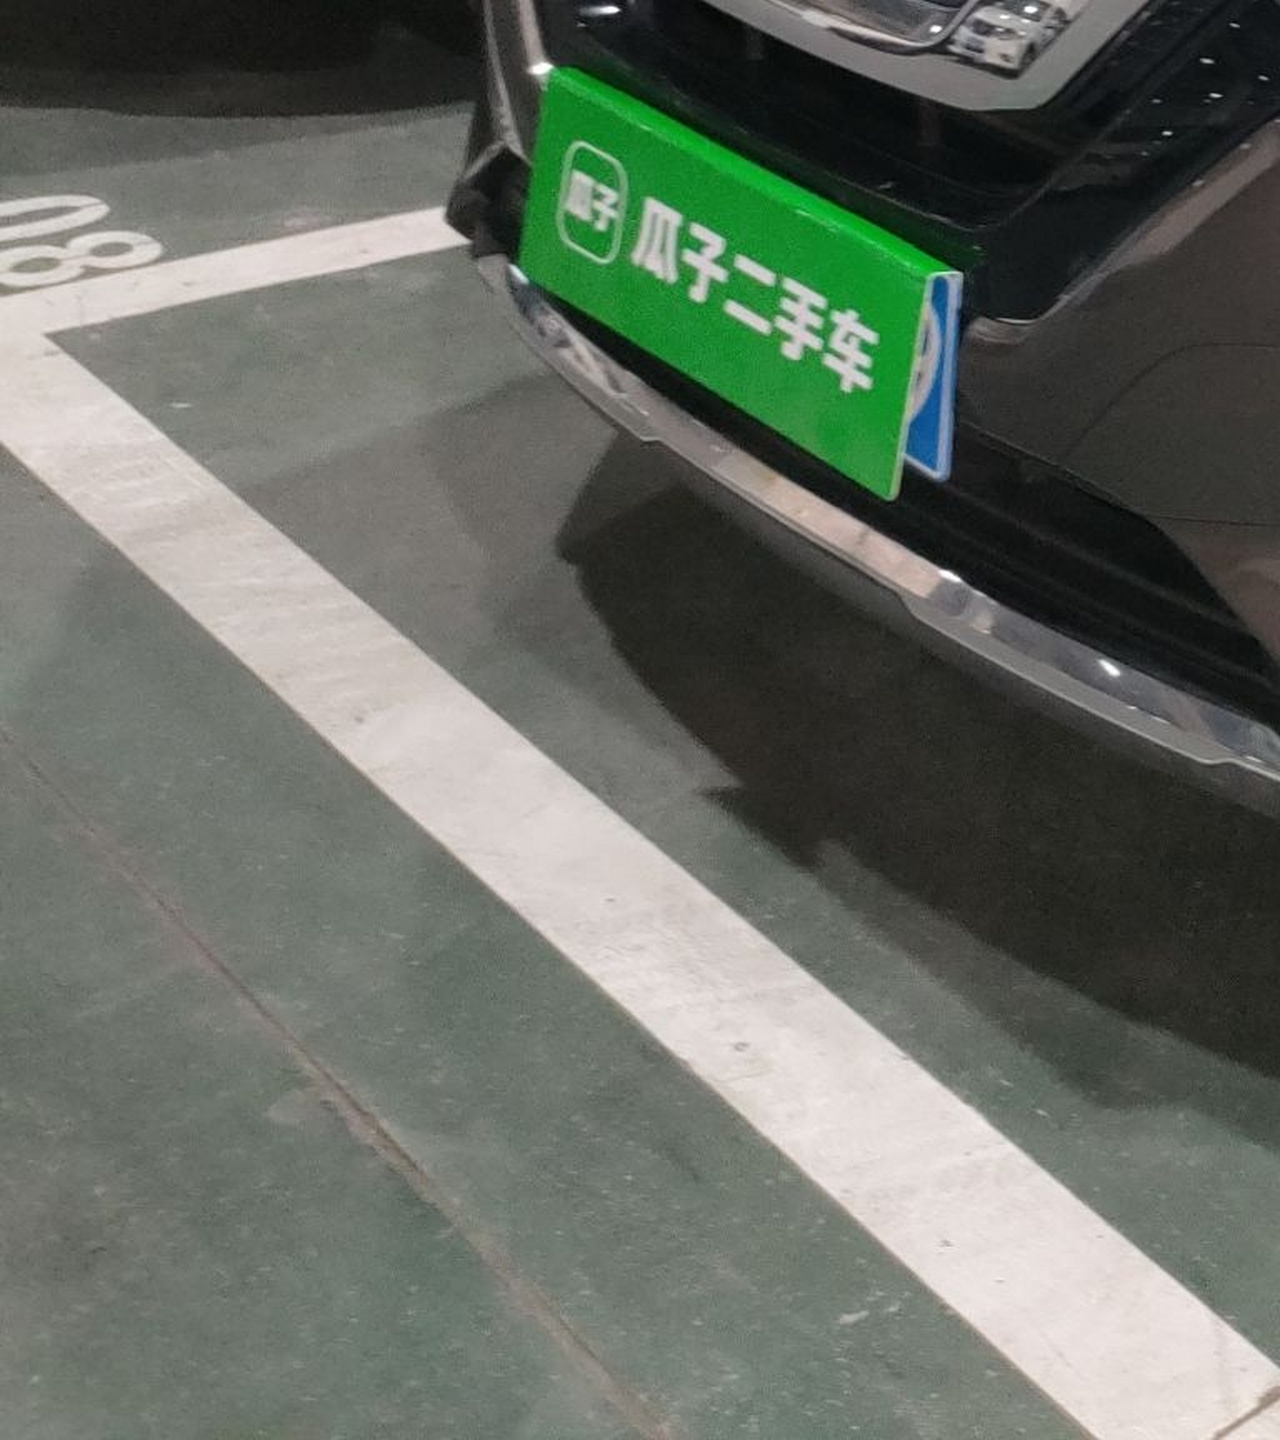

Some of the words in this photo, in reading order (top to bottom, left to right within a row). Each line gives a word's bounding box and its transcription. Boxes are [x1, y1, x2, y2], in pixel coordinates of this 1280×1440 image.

[631, 196, 880, 393] 瓜子二手车
